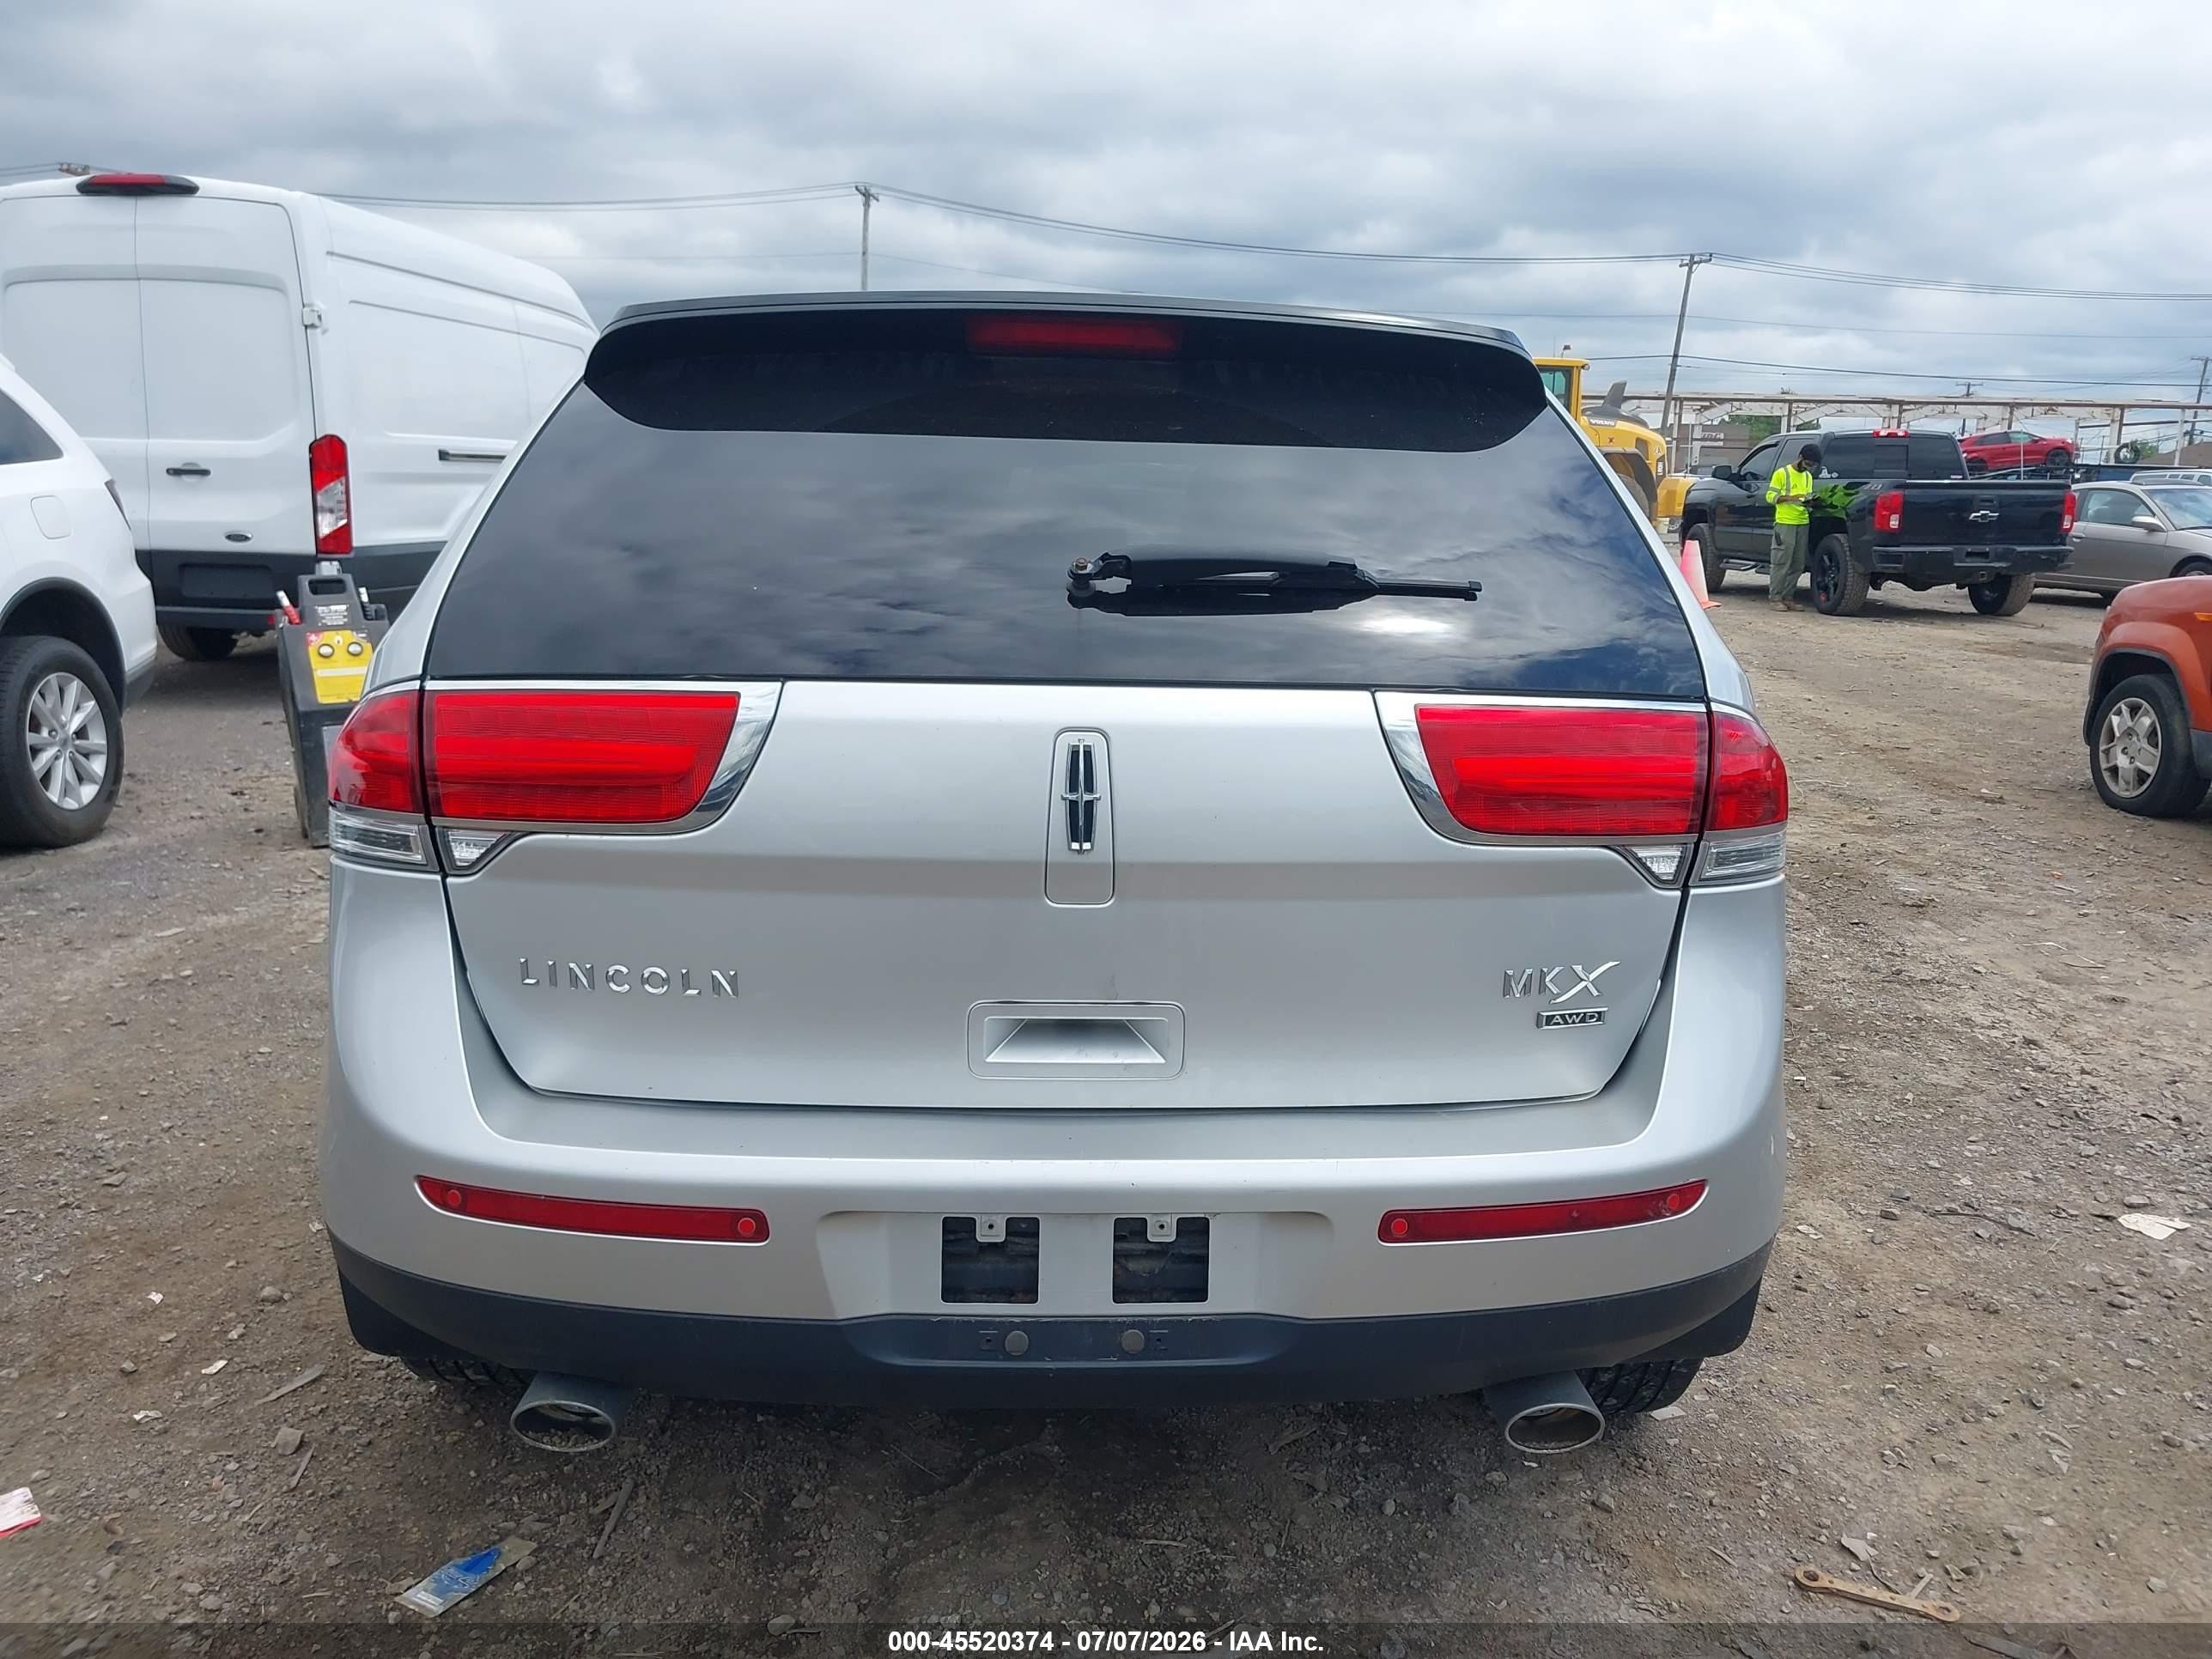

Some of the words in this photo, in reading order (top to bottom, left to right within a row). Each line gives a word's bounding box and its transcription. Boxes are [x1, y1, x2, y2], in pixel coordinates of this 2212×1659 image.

[519, 957, 739, 998] LINCOLN
[1504, 961, 1621, 1005] MKX
[1549, 1012, 1600, 1025] AWD
